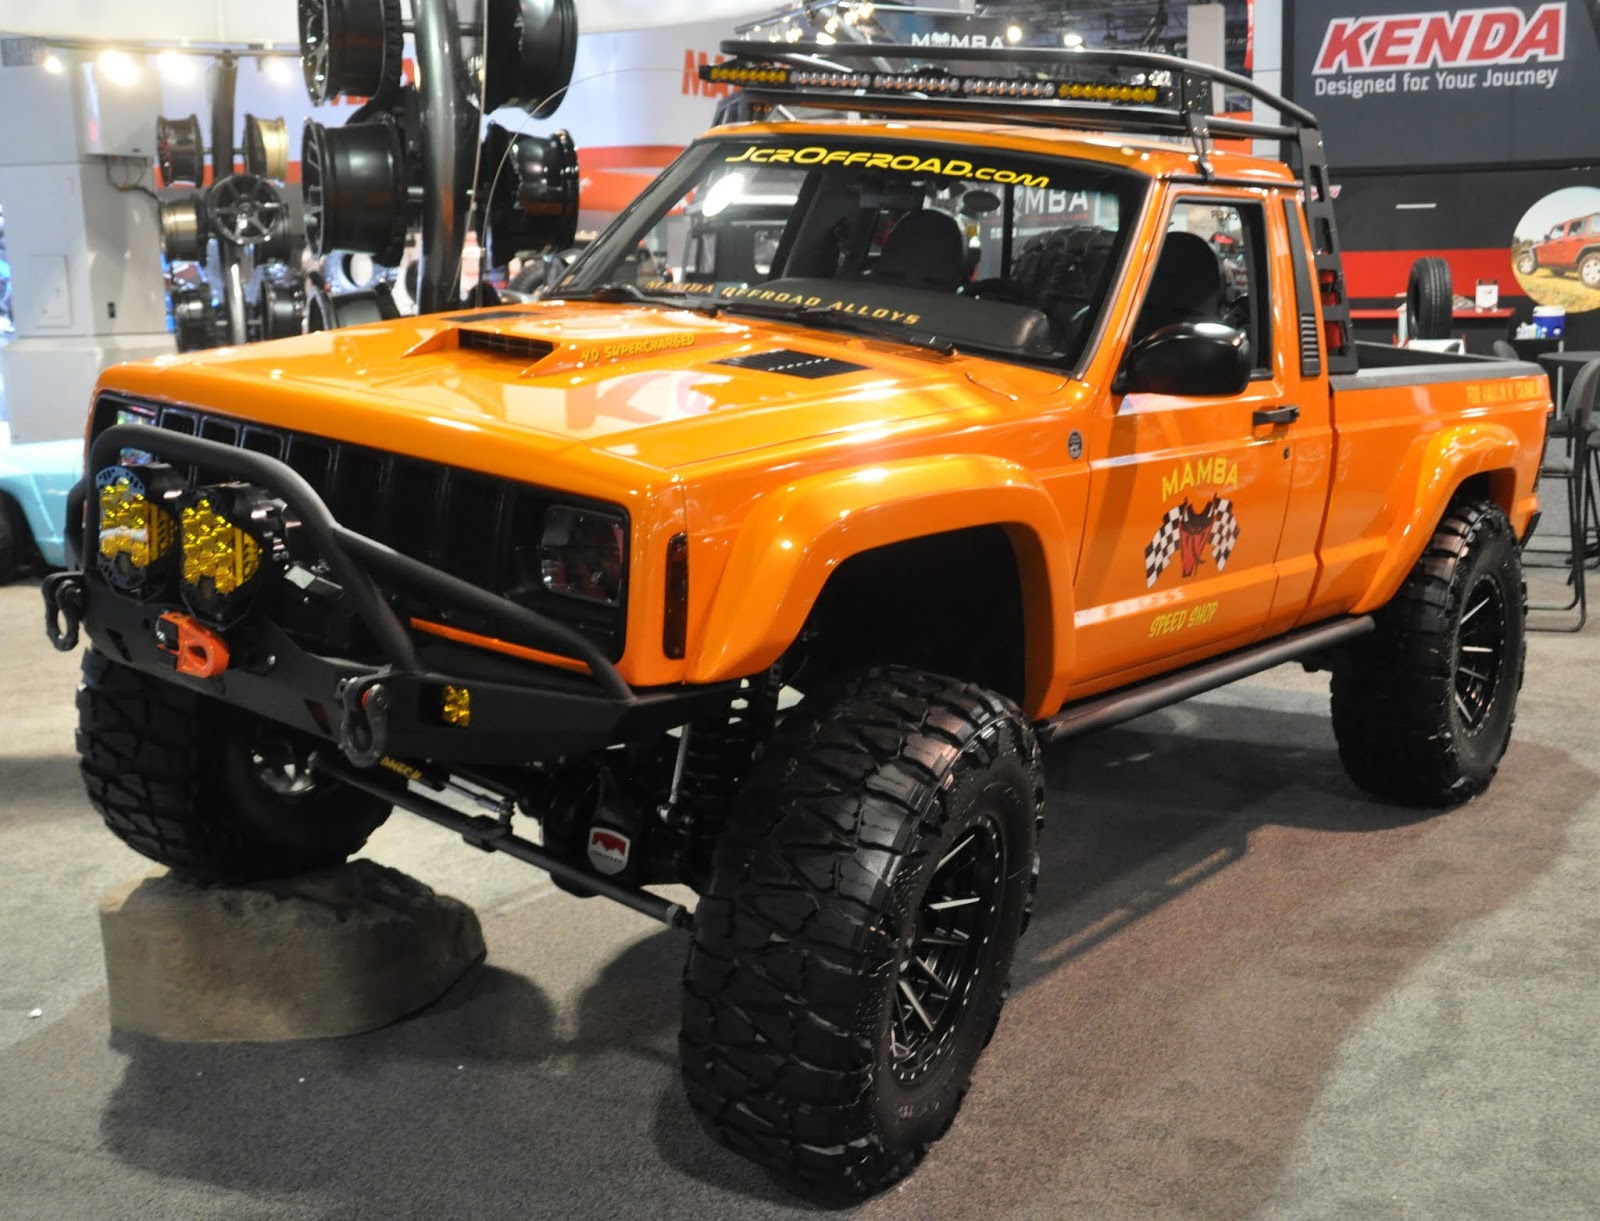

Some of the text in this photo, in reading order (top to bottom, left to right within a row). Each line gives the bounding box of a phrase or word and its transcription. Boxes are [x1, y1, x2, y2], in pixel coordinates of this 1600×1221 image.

[1312, 2, 1567, 75] KENDA
[1314, 67, 1559, 98] Designed for Your Journey
[644, 280, 921, 325] MAMBA OFFROAD ALLOYS
[604, 332, 696, 359] SUPERCHARGED
[1161, 457, 1239, 502] MAMBA
[1149, 601, 1219, 638] SPEED SHOP
